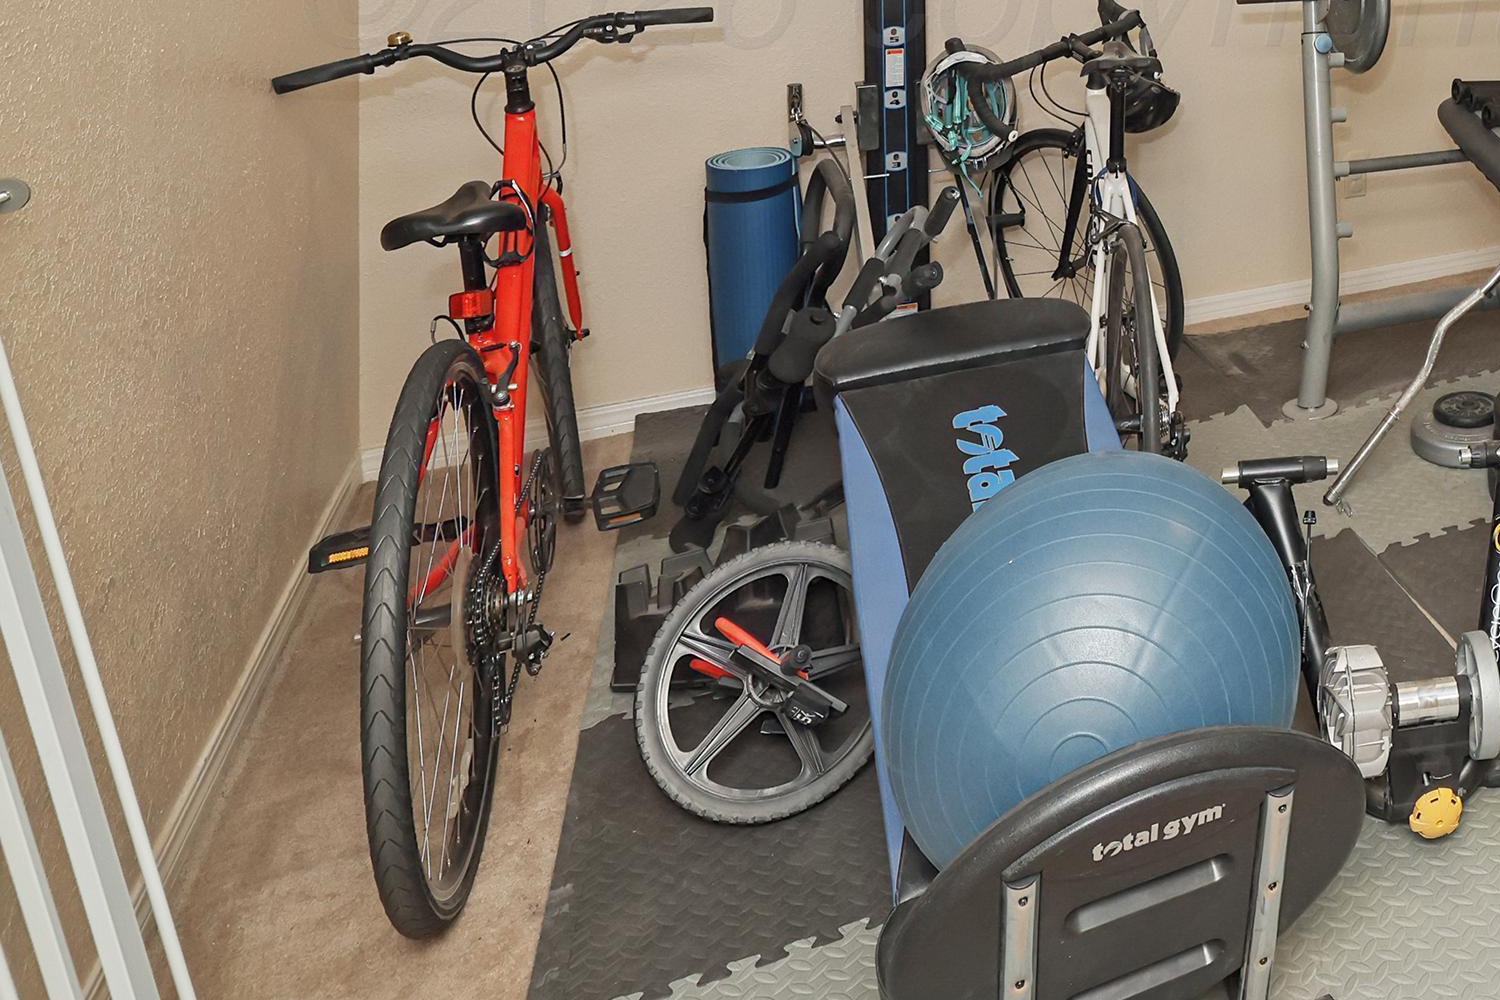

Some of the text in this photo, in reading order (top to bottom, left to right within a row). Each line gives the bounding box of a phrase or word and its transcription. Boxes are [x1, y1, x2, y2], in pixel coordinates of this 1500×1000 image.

[952, 405, 1020, 513] tota
[1091, 804, 1224, 862] total gym
